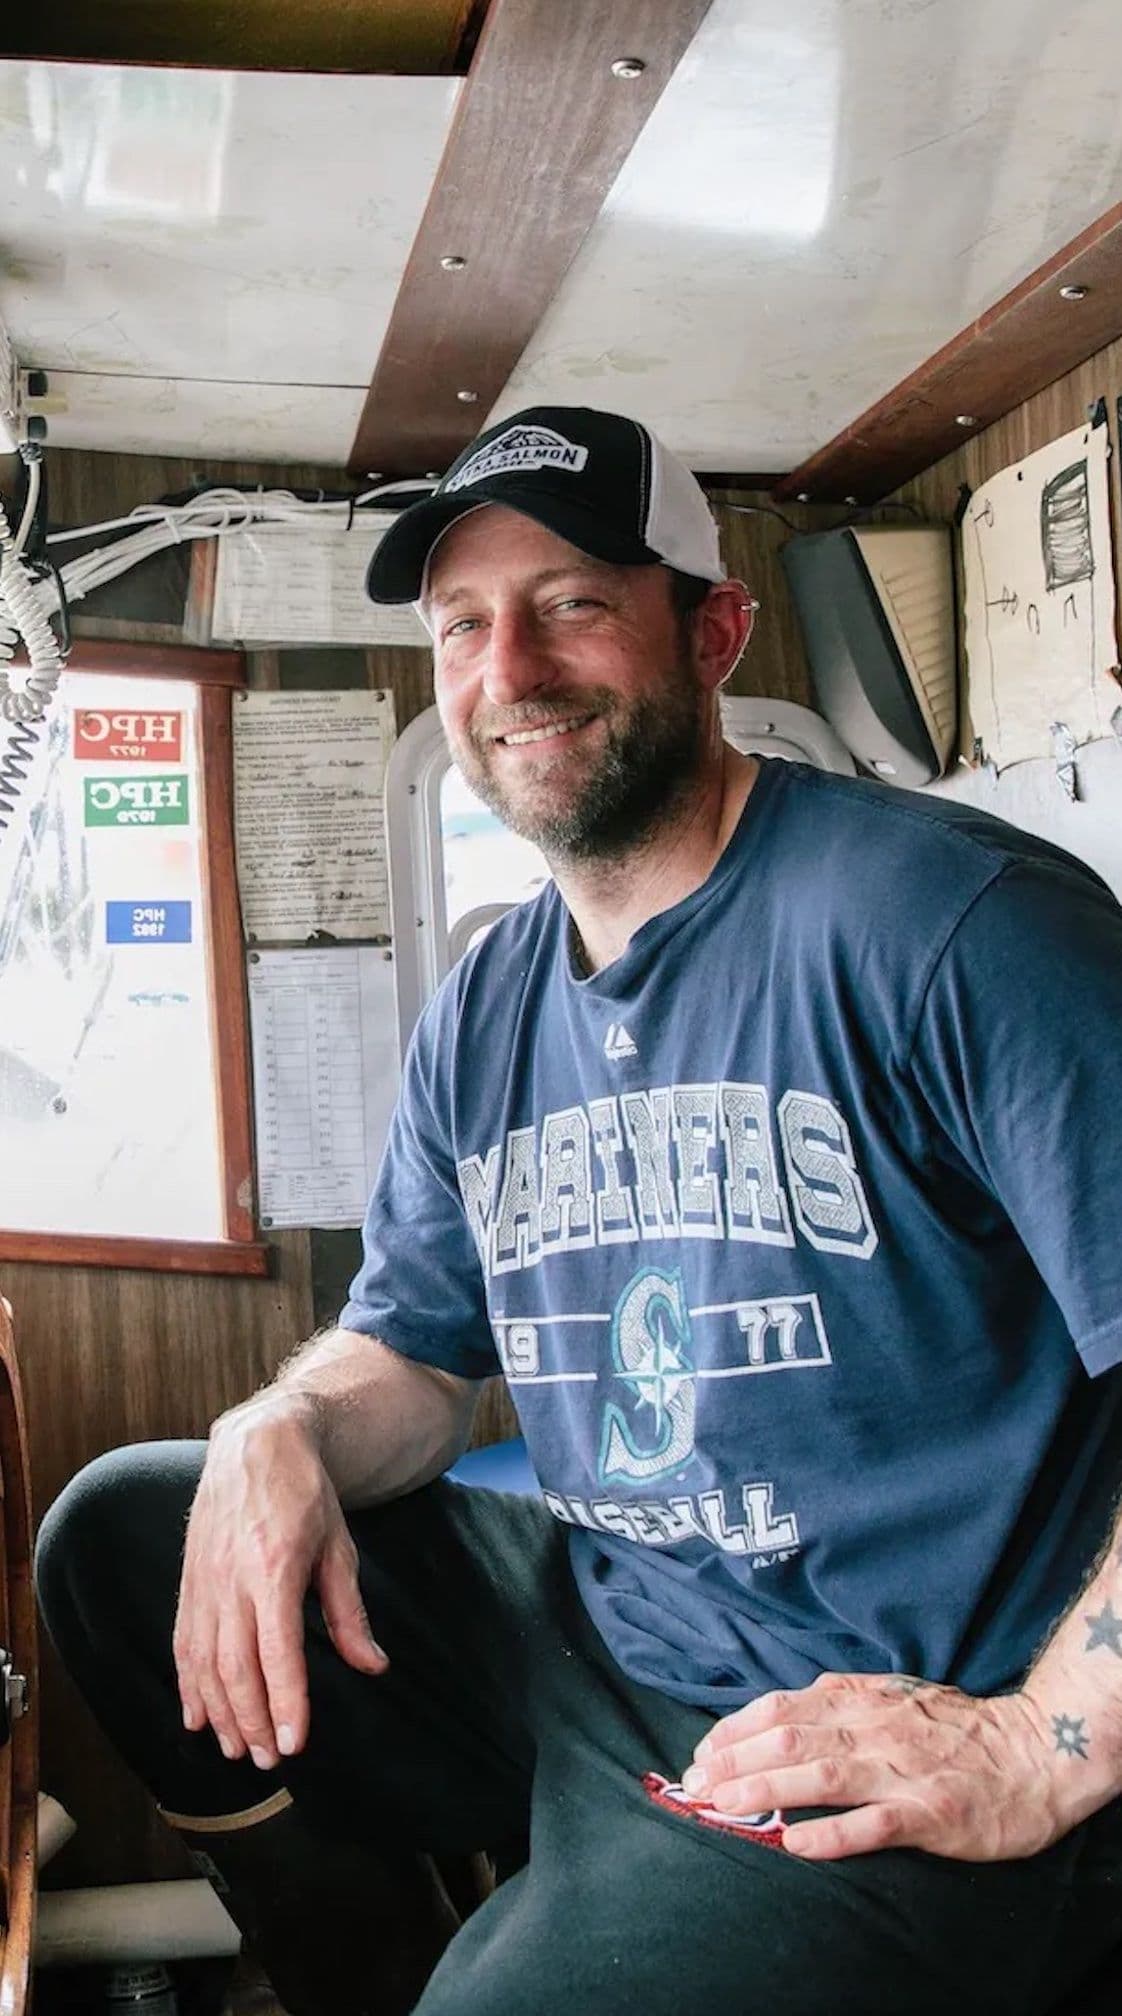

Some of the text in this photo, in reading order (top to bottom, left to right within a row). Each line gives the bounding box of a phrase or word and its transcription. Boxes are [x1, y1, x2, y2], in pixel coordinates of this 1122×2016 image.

[501, 447, 578, 465] SALMON
[456, 1081, 880, 1276] MARINERS
[736, 1306, 803, 1366] 77
